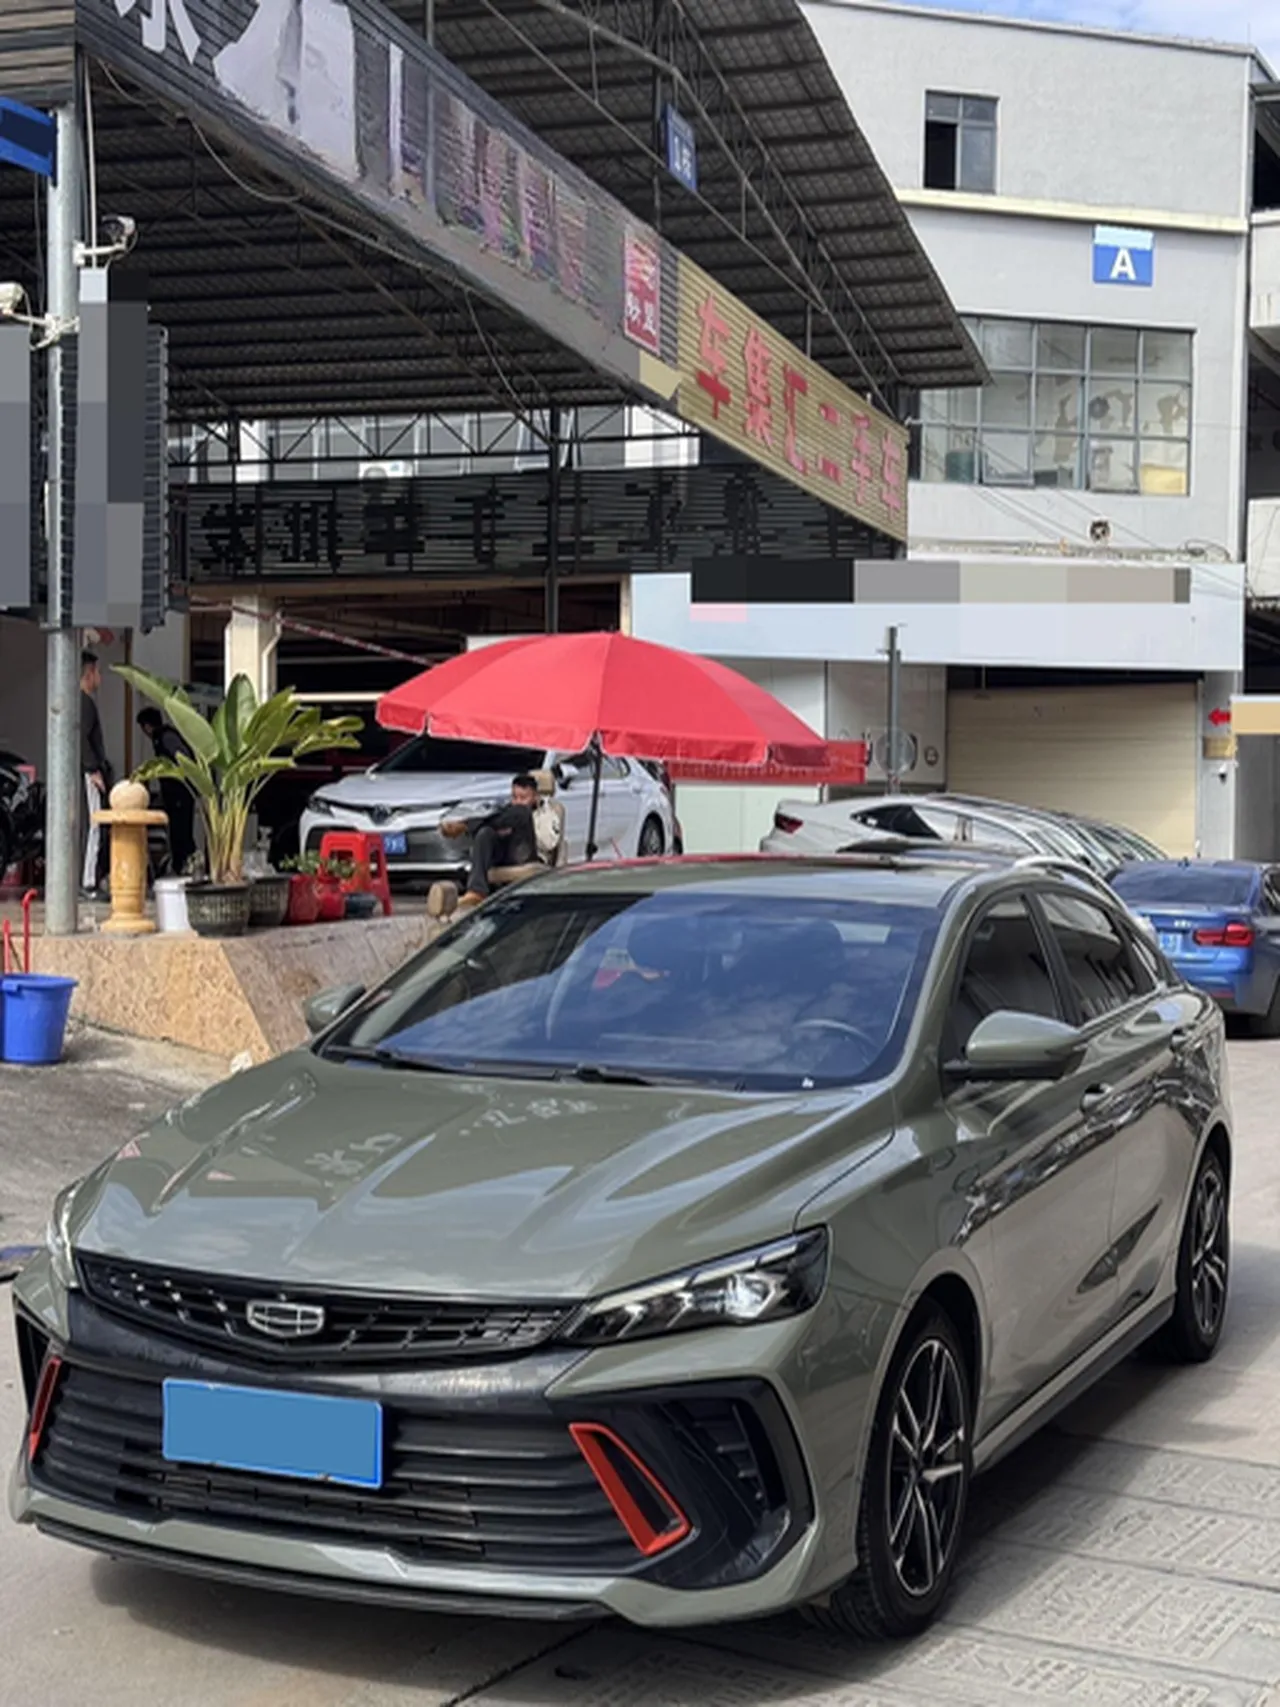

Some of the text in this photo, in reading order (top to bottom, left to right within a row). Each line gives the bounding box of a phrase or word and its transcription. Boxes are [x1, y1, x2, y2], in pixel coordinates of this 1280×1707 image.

[1109, 247, 1137, 281] A
[695, 289, 902, 522] 车集汇二手车
